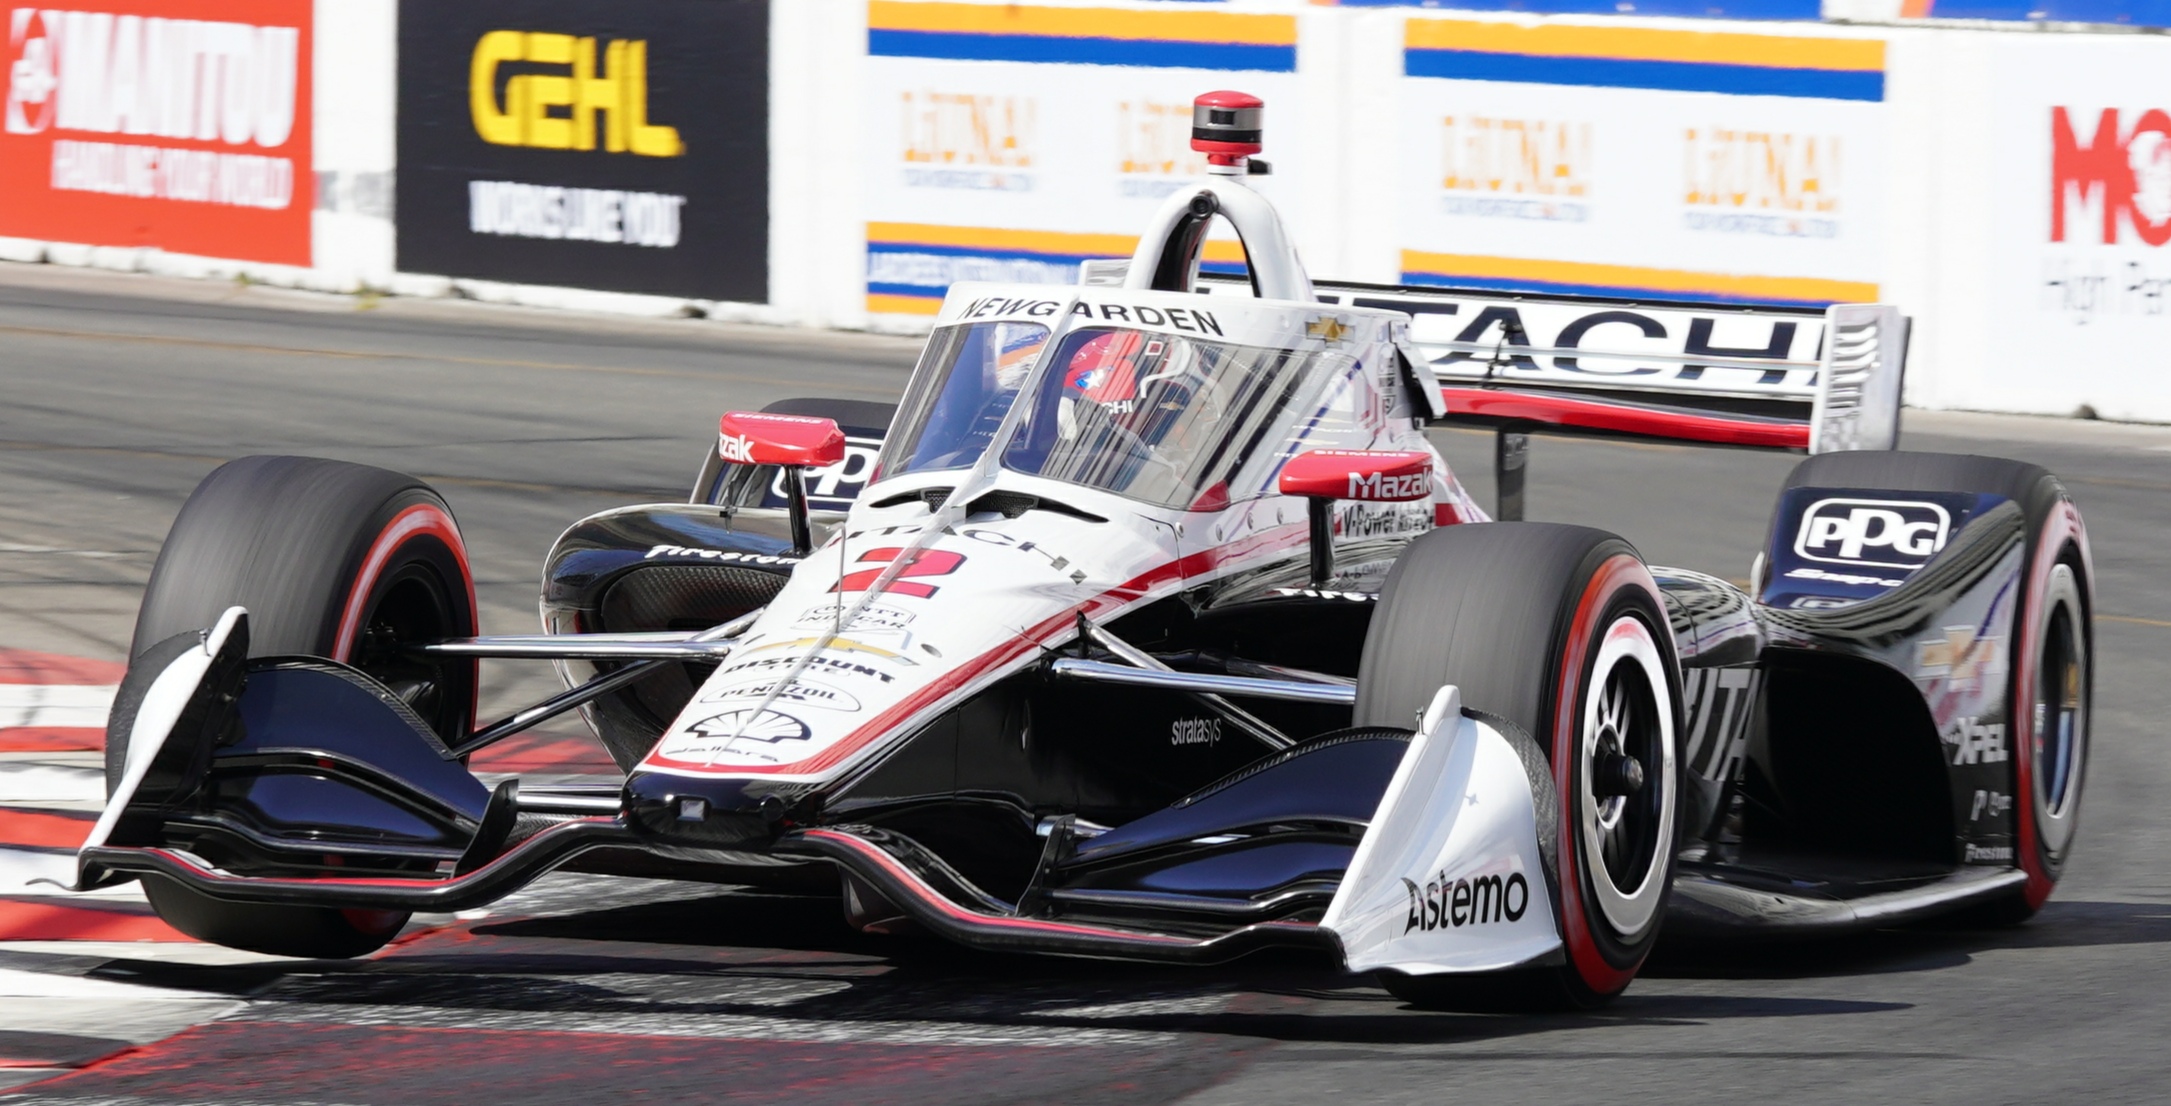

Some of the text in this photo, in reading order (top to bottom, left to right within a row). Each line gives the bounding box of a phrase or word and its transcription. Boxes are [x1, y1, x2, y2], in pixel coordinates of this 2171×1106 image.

[469, 30, 687, 157] GEHL
[957, 297, 1225, 337] NEWGARDEN
[1313, 449, 1411, 458] SIEMENS
[1348, 467, 1435, 499] Mazak
[1806, 507, 1938, 558] PPG
[643, 544, 806, 565] Fireston
[826, 547, 968, 600] 2
[1171, 715, 1222, 748] stratasys
[1400, 869, 1529, 937] Astemo
